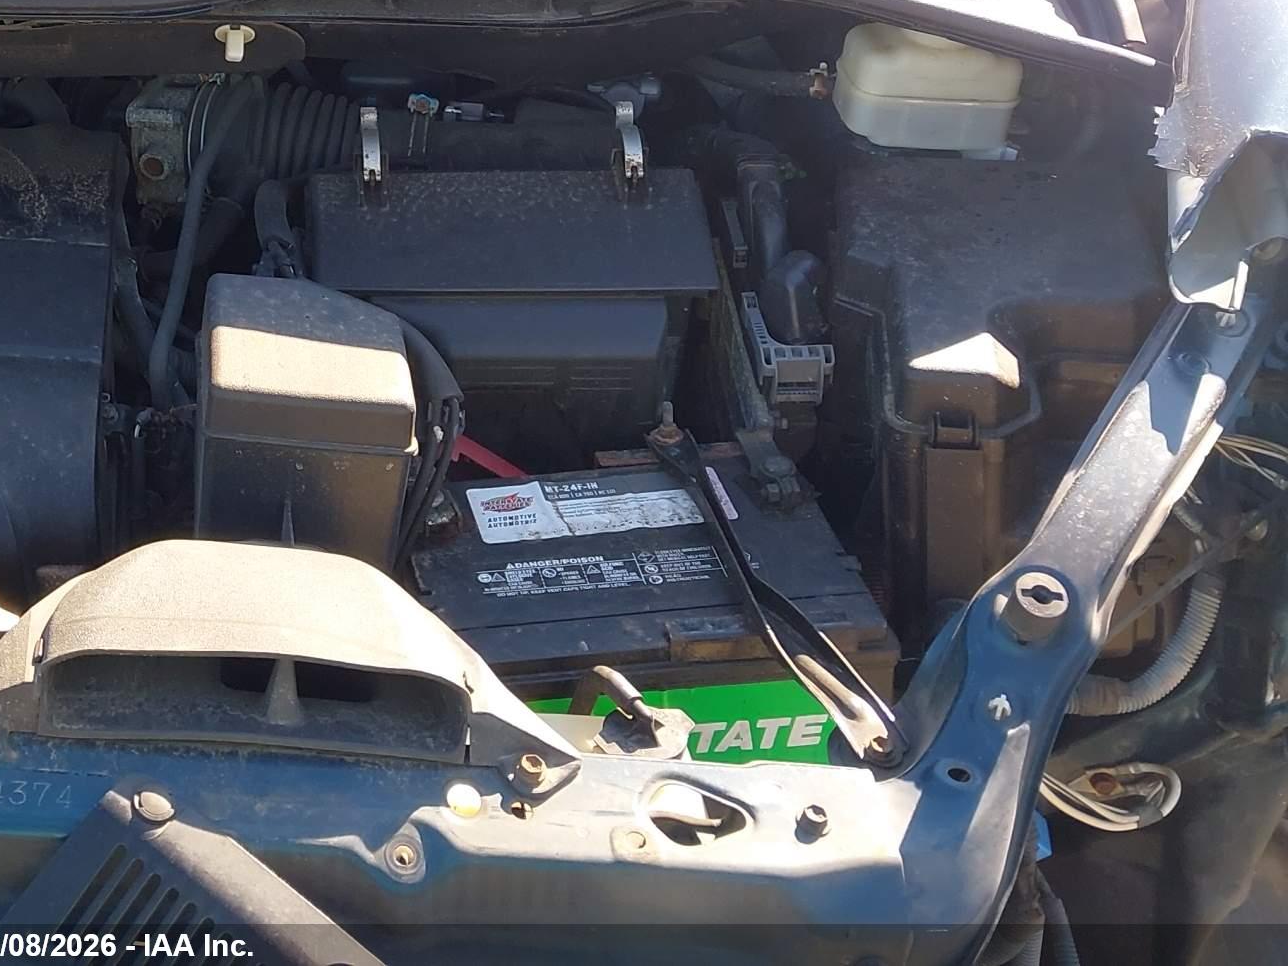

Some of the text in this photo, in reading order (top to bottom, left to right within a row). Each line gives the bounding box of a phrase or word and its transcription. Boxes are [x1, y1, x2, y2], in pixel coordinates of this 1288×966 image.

[488, 513, 537, 523] AUTOMOTIVE
[488, 519, 537, 528] AUTOMOTRIZ
[514, 556, 604, 569] DANGER/POISON
